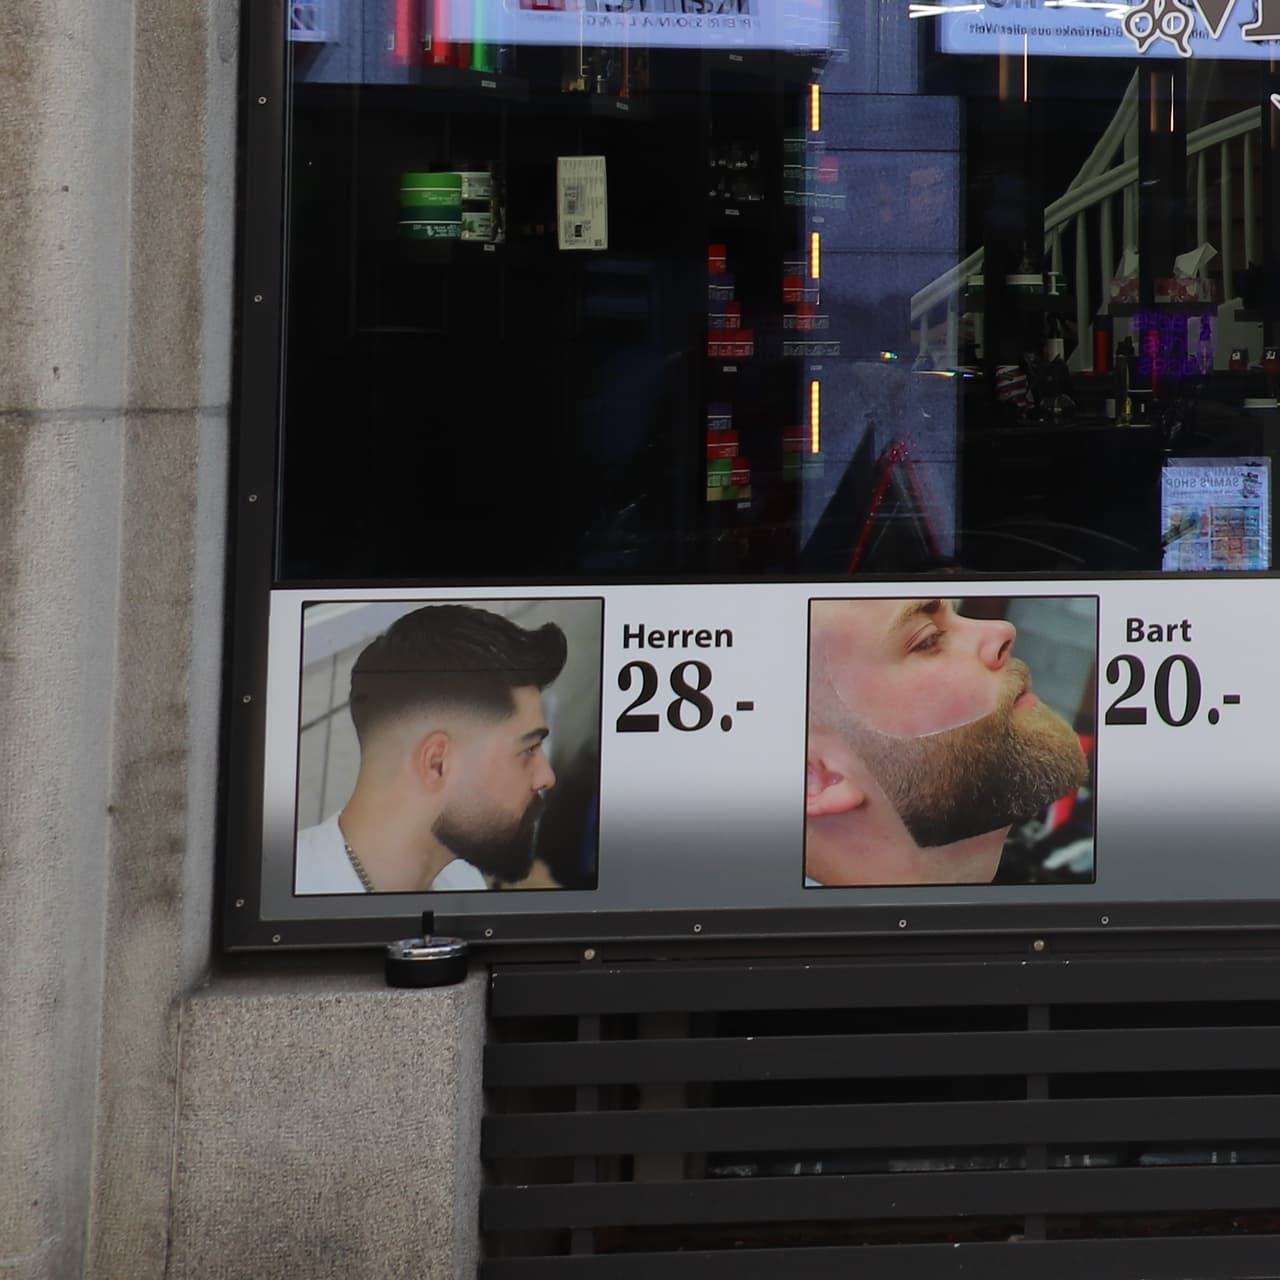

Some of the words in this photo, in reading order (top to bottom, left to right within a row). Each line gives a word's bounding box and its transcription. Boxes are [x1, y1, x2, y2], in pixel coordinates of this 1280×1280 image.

[623, 623, 734, 650] Herren
[1126, 617, 1193, 644] Bart
[615, 660, 755, 734] 28.-
[1104, 654, 1242, 728] 20.-
